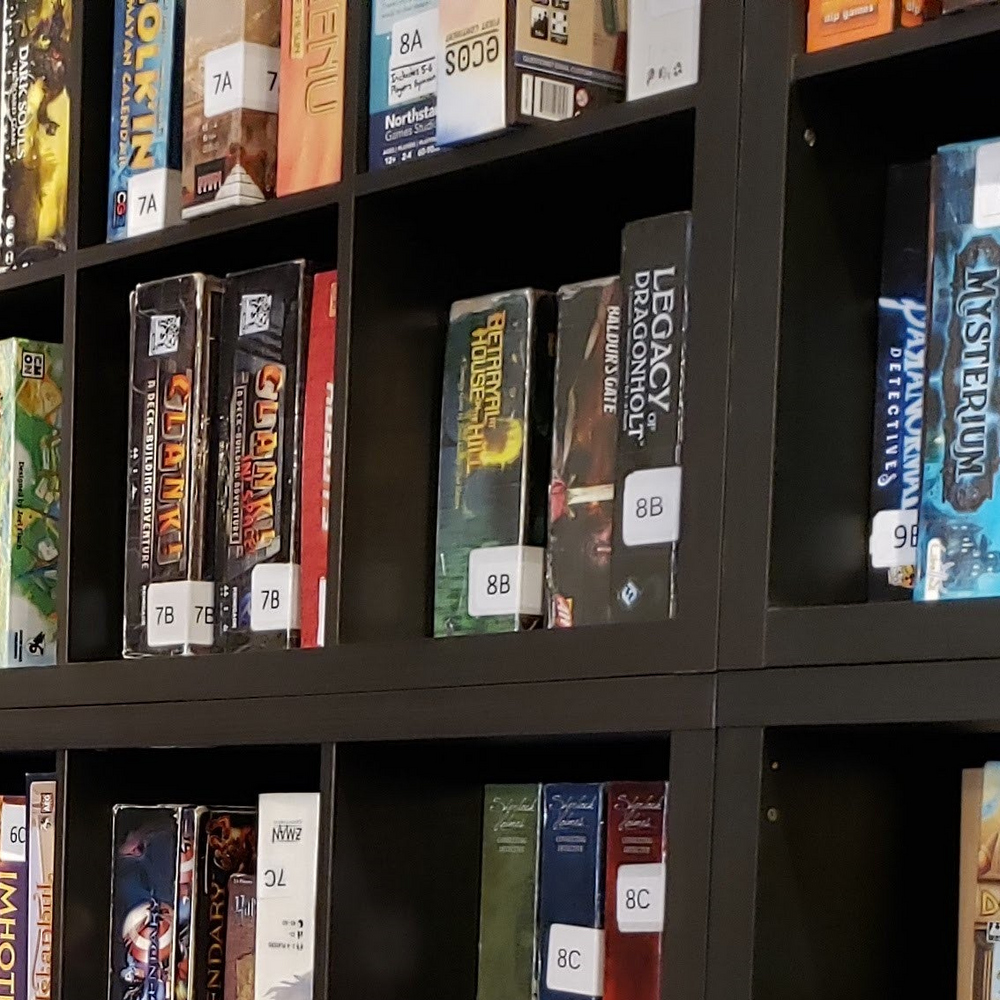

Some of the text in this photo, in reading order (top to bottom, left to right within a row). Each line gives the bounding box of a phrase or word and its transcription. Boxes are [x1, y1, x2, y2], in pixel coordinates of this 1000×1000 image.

[400, 29, 423, 54] 8A
[213, 71, 233, 95] 7A
[16, 45, 29, 160] DARK SOULS
[138, 194, 157, 216] 7A
[648, 265, 677, 414] LEGACY
[627, 270, 651, 447] DRAGONHOLT
[950, 266, 999, 481] MYSTERIUM
[877, 346, 902, 488] DETECTIVES
[156, 373, 190, 566] CLANK!
[250, 363, 287, 553] CLANK!
[141, 391, 156, 570] DECK-BUILDING ADVENTURE
[636, 498, 663, 518] 8B
[486, 574, 511, 595] 8B
[261, 590, 279, 610] 7B
[156, 607, 174, 625] 7B
[10, 825, 25, 844] 6C
[272, 826, 303, 843] ZMAN
[265, 868, 287, 887] 7C
[625, 888, 650, 909] 8C
[557, 949, 581, 970] 8C
